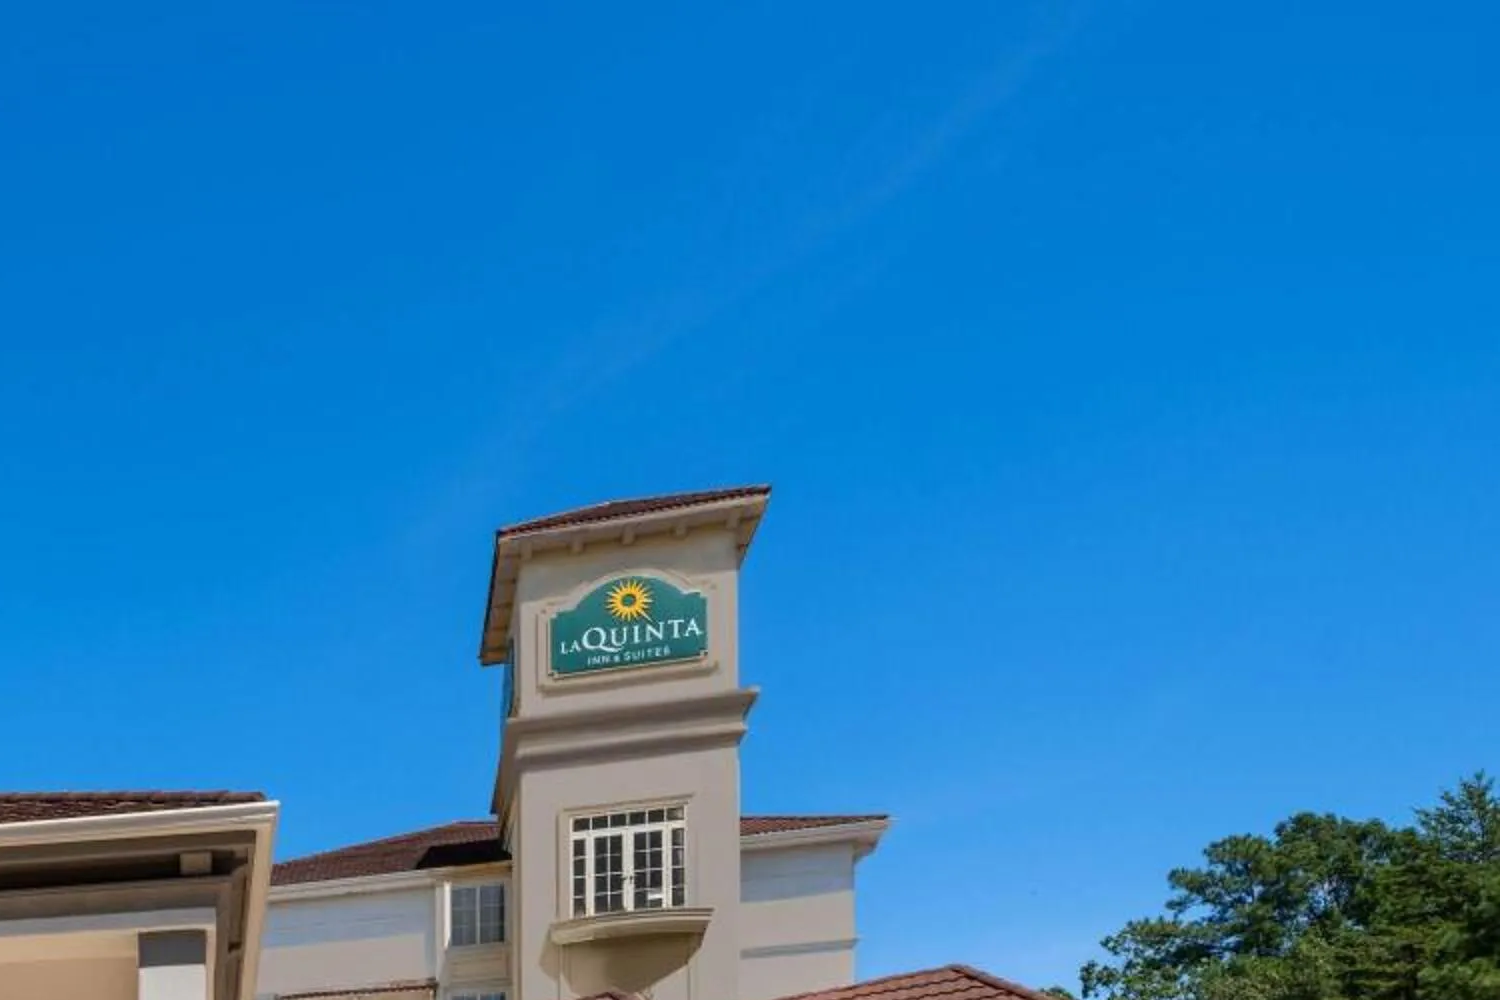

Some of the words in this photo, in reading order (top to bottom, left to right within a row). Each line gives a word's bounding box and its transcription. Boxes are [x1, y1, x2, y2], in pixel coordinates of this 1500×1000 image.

[560, 640, 582, 654] LA
[581, 618, 704, 652] QUINTA
[587, 653, 611, 666] INN
[623, 645, 672, 661] SUITES
